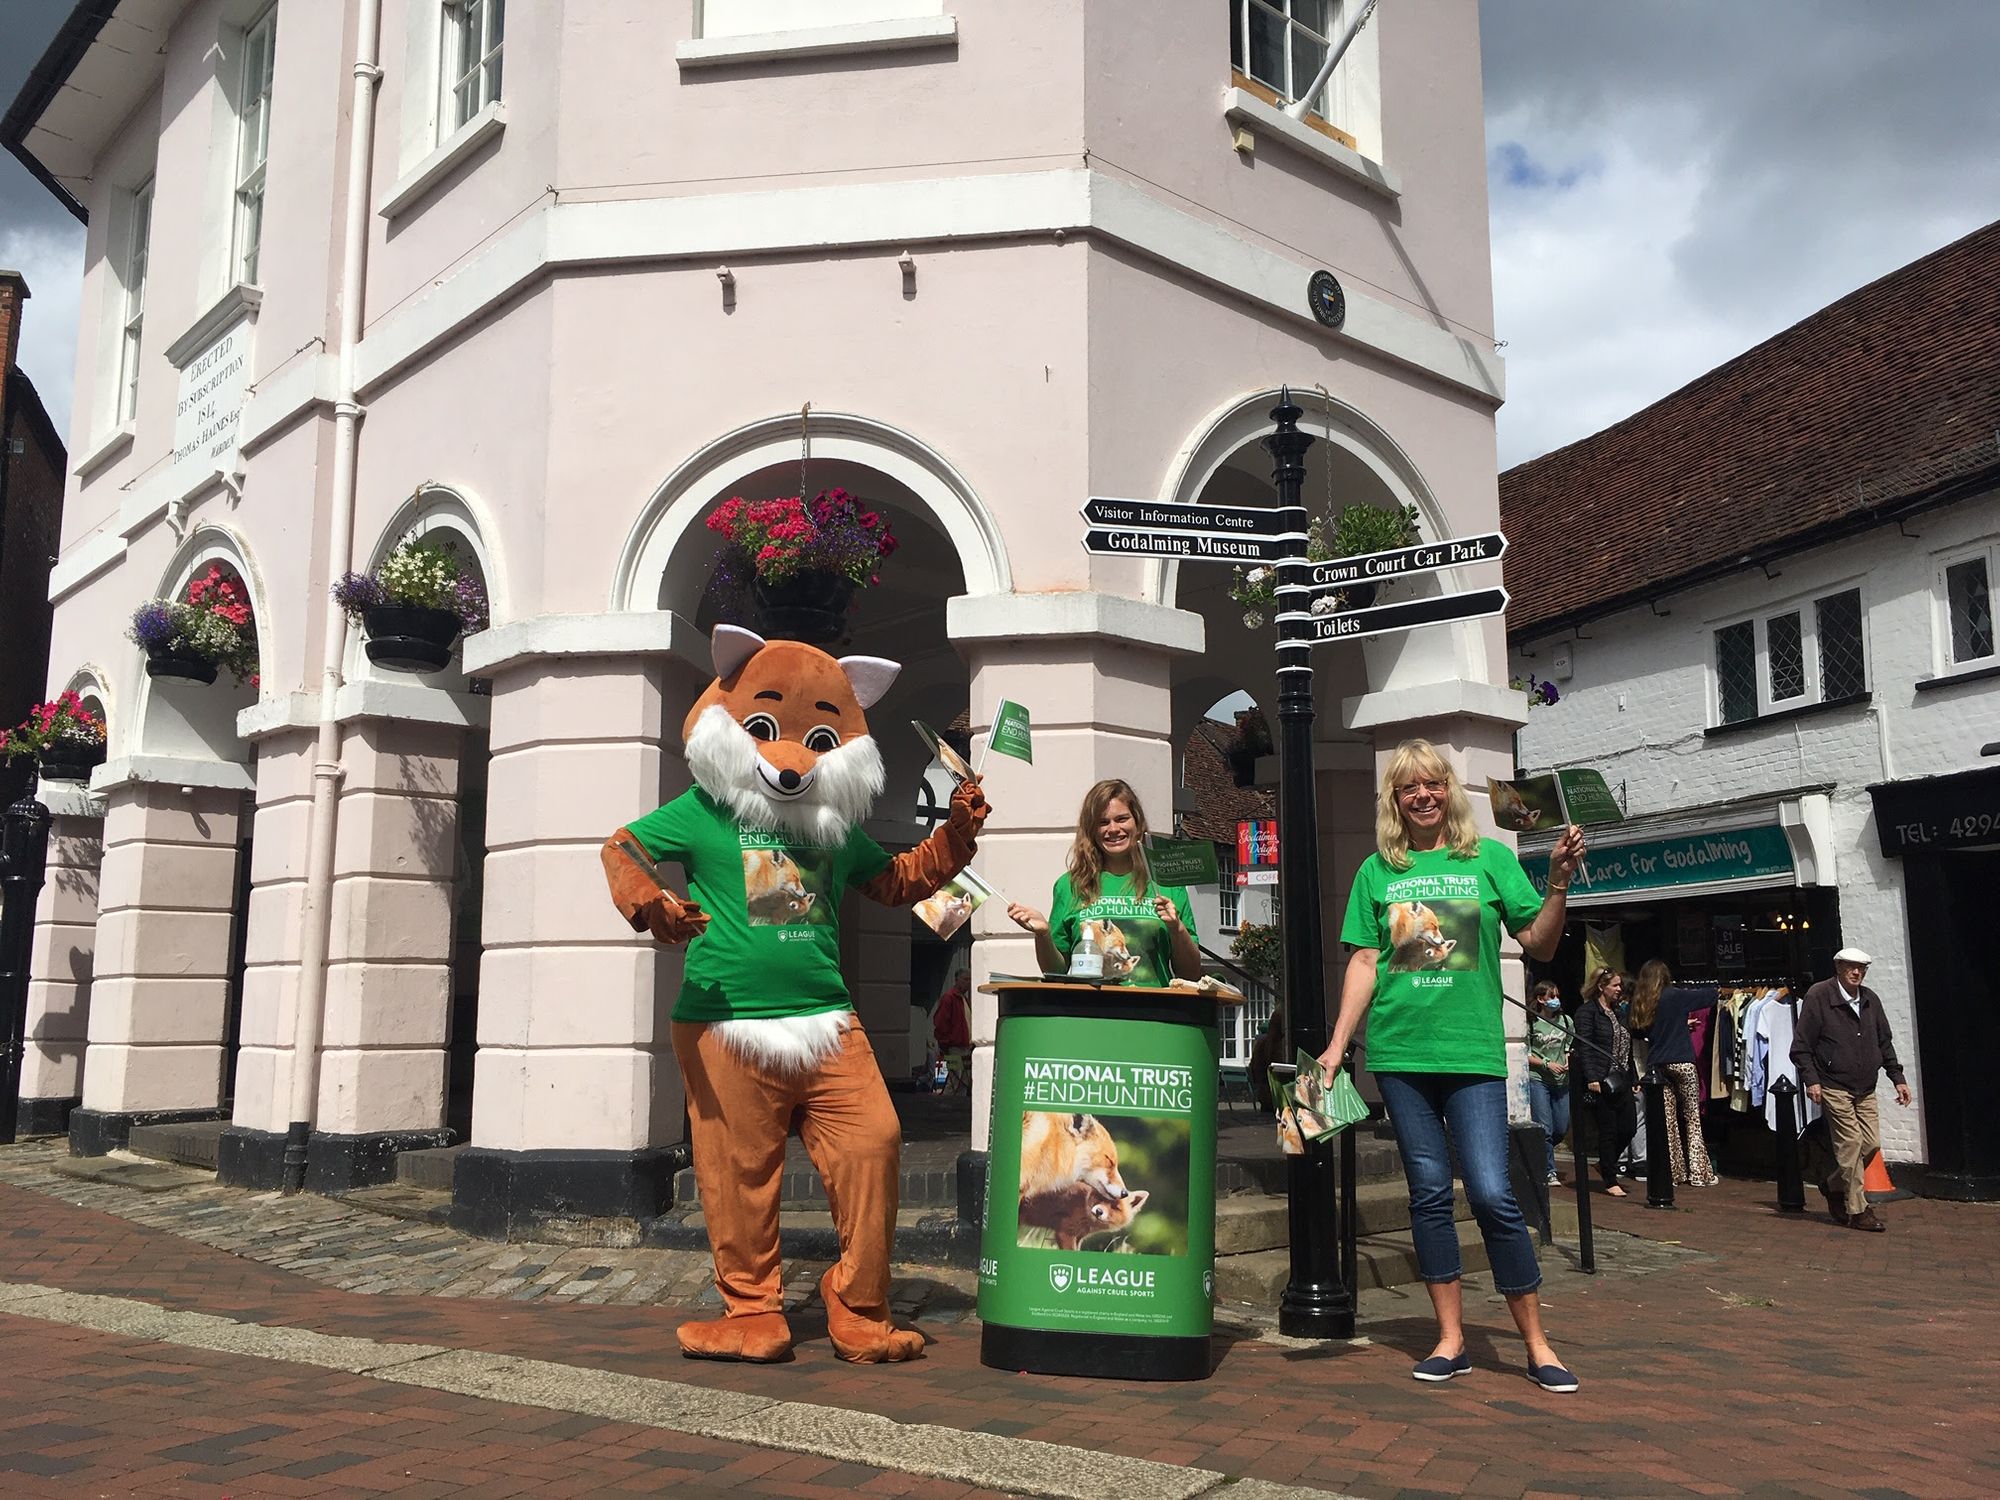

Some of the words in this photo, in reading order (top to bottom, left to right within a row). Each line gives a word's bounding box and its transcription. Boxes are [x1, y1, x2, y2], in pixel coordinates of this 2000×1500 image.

[190, 337, 233, 383] ERECTED
[177, 397, 189, 417] BY
[173, 435, 200, 465] THOMAS
[201, 415, 229, 444] HAINES
[1095, 505, 1133, 520] Visitor
[1140, 508, 1209, 525] Information
[1215, 514, 1254, 528] Centre
[1107, 532, 1190, 555] Godalming
[1196, 537, 1261, 556] Museum
[1312, 566, 1358, 583] Crown
[1364, 555, 1406, 575] Court
[1414, 549, 1442, 567] Car
[1450, 540, 1486, 562] Park
[1313, 618, 1360, 638] Toilets
[1568, 793, 1588, 804] END
[739, 833, 772, 846] END
[1895, 823, 1939, 845] TEL:
[1630, 852, 1658, 875] for
[1663, 838, 1752, 867] Godalming
[1385, 888, 1413, 901] END
[1416, 885, 1480, 897] HUNTING
[1387, 877, 1440, 893] NATIONAL
[1079, 905, 1104, 918] END
[1718, 943, 1741, 955] SALE
[1421, 976, 1454, 984] LEAGUE
[1024, 1062, 1125, 1083] NATIONAL
[1131, 1068, 1193, 1088] TRUST:
[1024, 1080, 1192, 1109] #ENDHUNTING
[1076, 1267, 1155, 1287] LEAGUE
[1076, 1287, 1106, 1295] AGAINST
[1106, 1288, 1129, 1297] CRUEL
[1130, 1289, 1155, 1298] SPORTS
